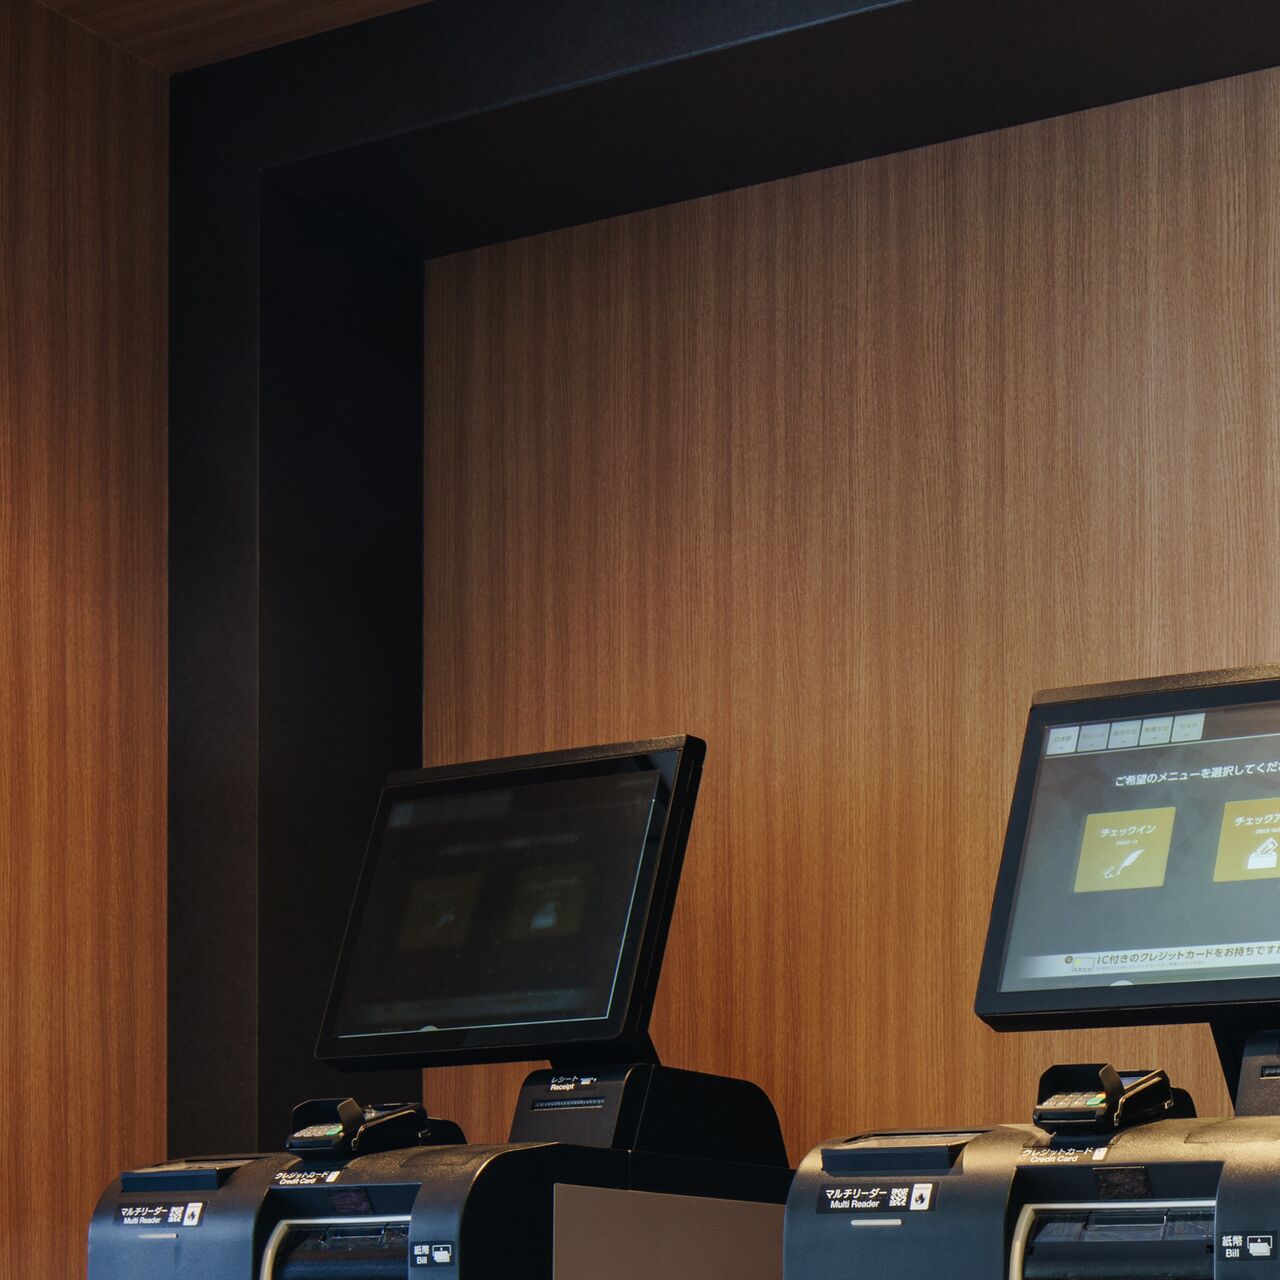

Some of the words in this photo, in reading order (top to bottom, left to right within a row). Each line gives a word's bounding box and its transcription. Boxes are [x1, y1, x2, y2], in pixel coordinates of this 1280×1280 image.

[1100, 825, 1156, 839] チェックイン
[551, 1075, 579, 1084] レシート
[550, 1083, 575, 1091] Receipt
[1022, 1147, 1094, 1157] クレジットカード
[1030, 1155, 1057, 1163] Credit
[825, 1187, 888, 1199] マルチリーダー
[830, 1200, 850, 1209] Multi
[851, 1199, 880, 1208] Reader
[121, 1206, 168, 1217] マルチリーダー
[123, 1216, 139, 1225] Multi
[139, 1216, 162, 1224] Reader
[1222, 1235, 1243, 1248] 紙幣
[1225, 1249, 1240, 1258] Bill
